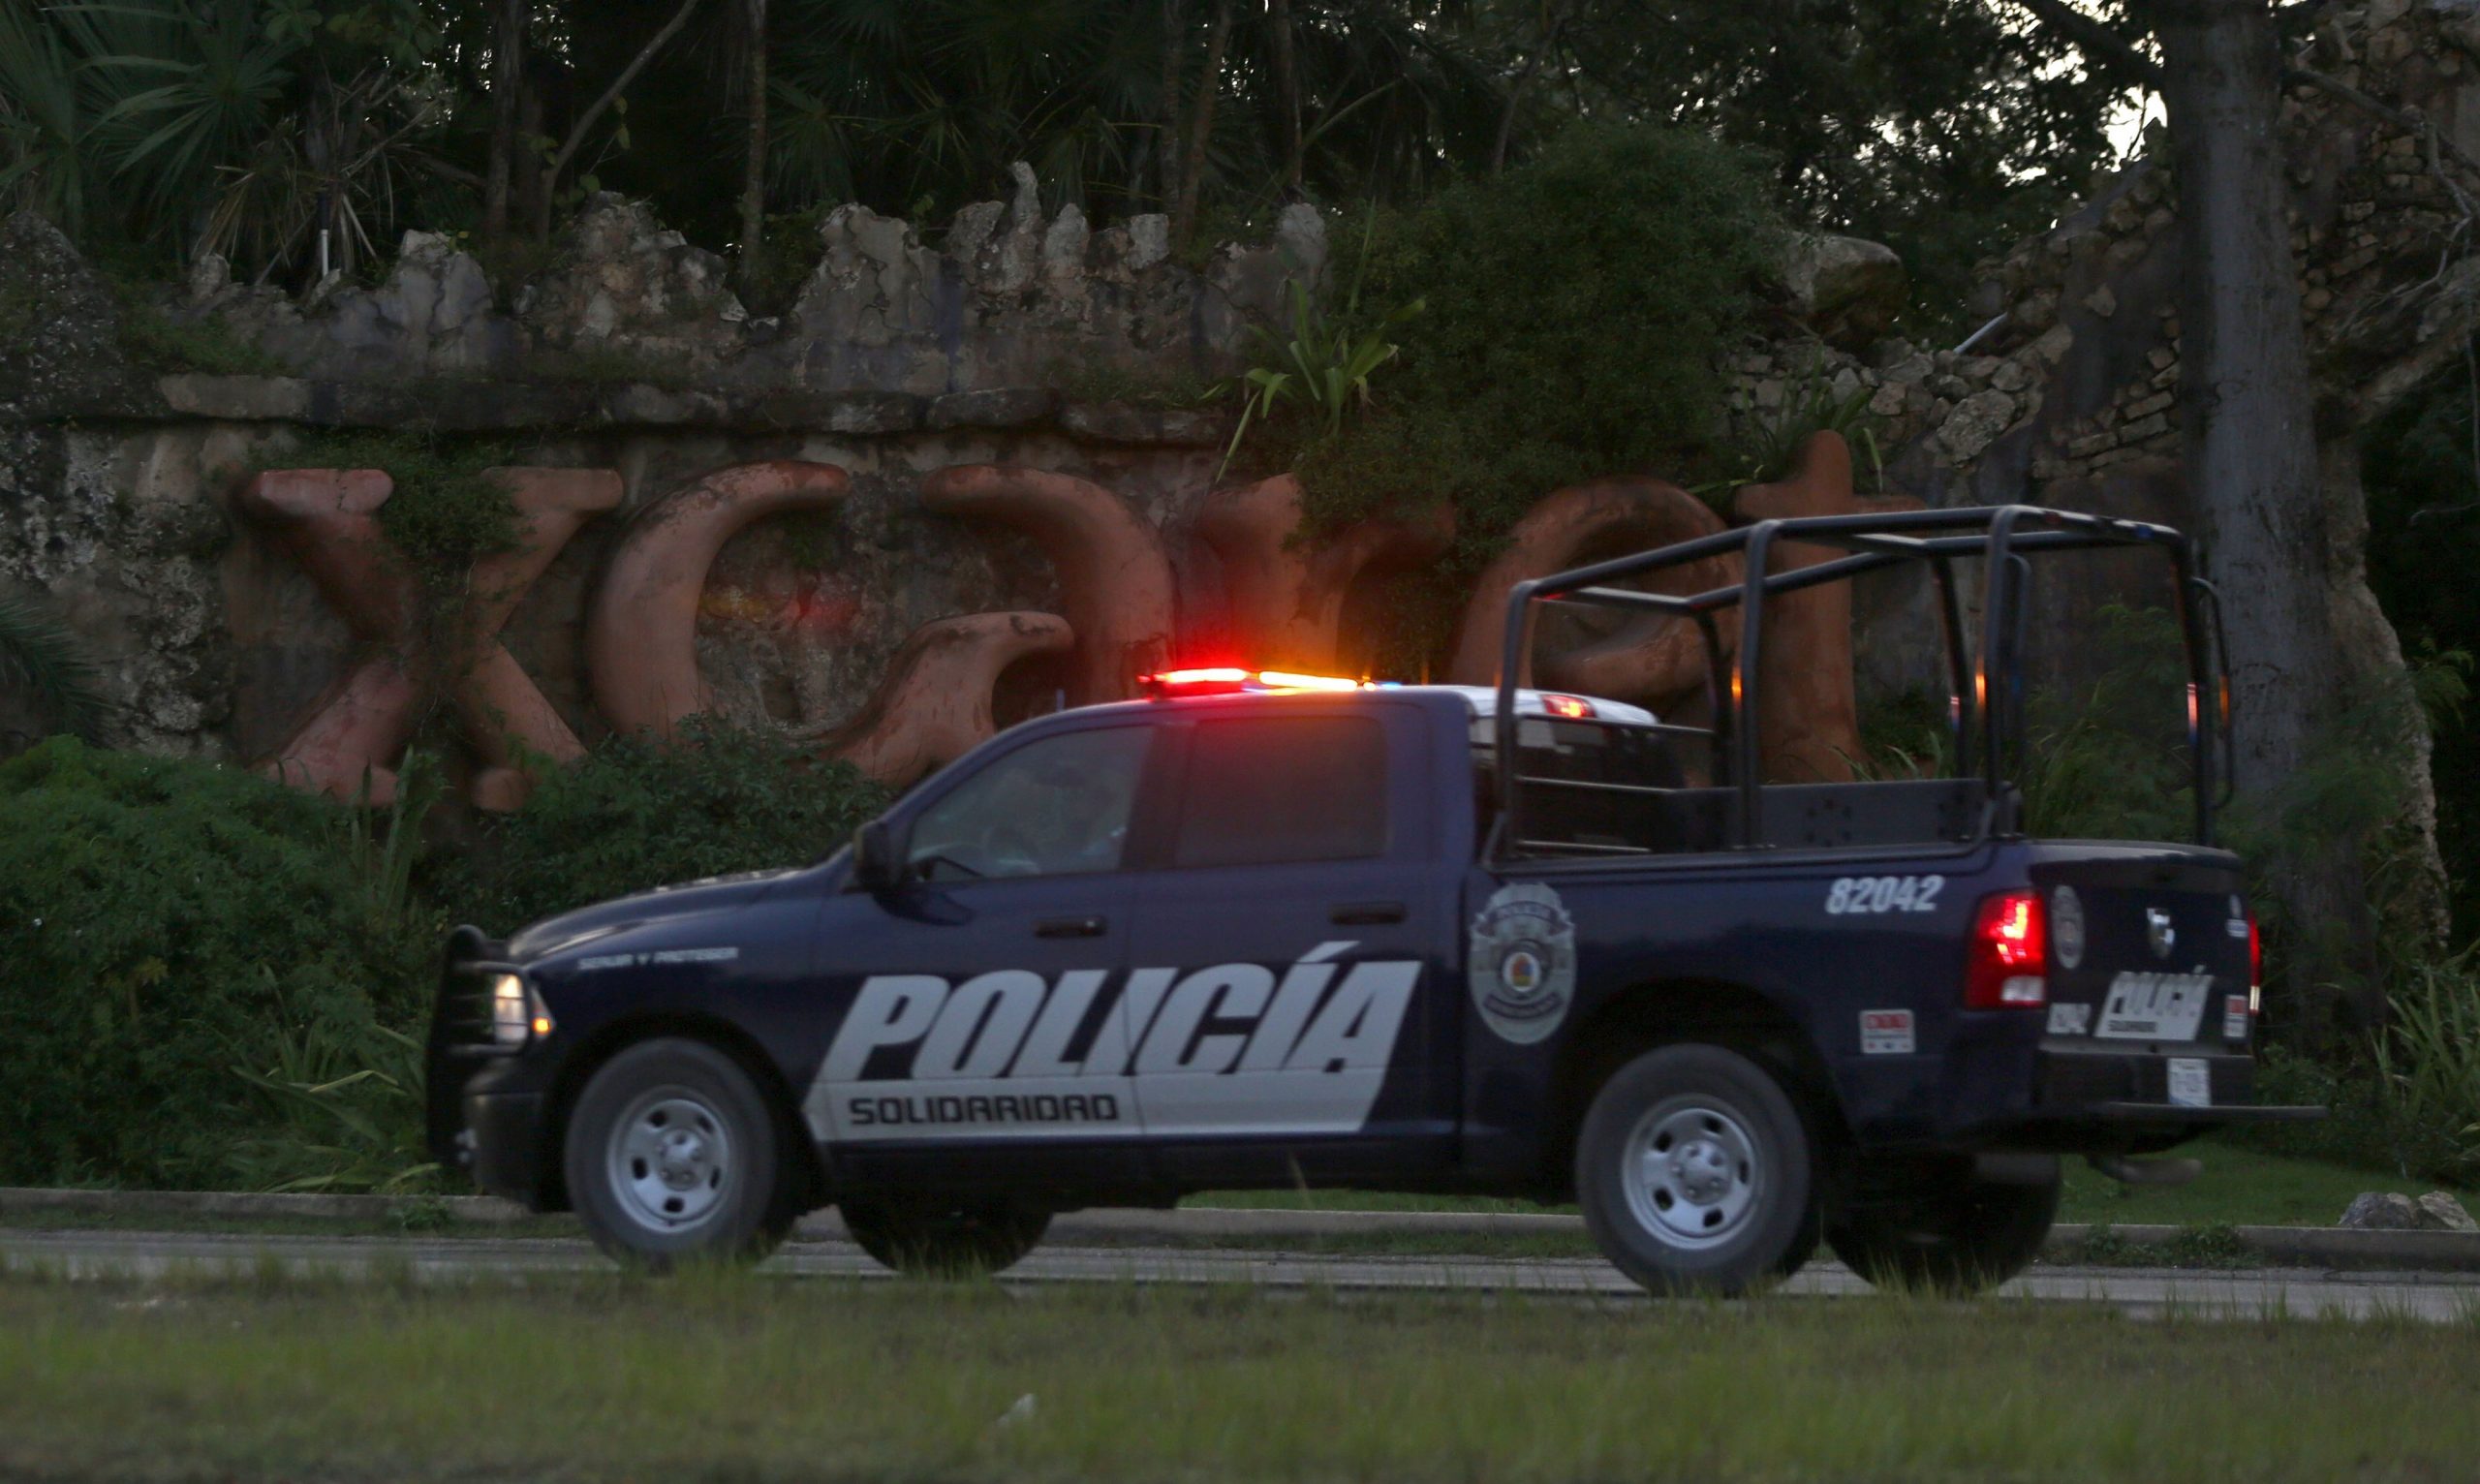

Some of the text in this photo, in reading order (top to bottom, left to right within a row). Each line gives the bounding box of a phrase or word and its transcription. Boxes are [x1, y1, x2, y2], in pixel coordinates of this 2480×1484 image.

[1826, 876, 1944, 913] 82042
[816, 941, 1424, 1081] POLICÍA
[849, 1094, 1120, 1125] SOLIDARIDAD
